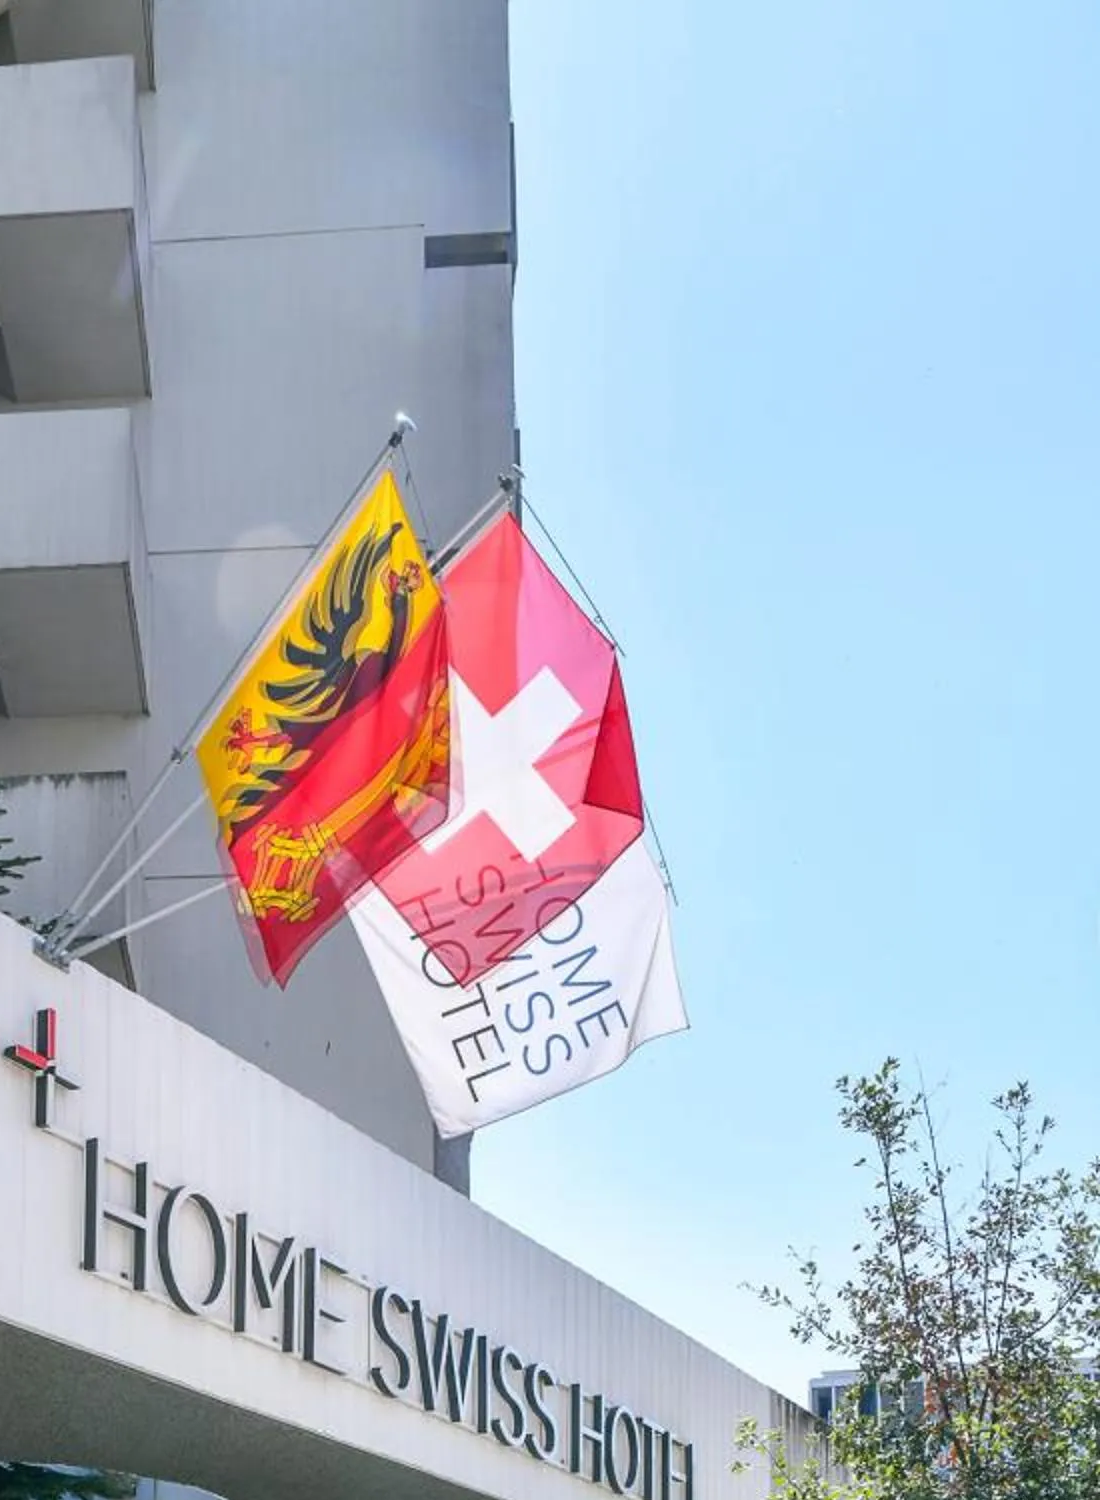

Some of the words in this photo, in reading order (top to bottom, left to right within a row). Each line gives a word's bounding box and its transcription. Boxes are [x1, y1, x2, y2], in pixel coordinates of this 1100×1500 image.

[399, 887, 511, 1103] HOTEL
[455, 864, 573, 1076] SWISS
[508, 845, 630, 1049] HOME
[79, 1137, 350, 1375] HOME
[370, 1285, 560, 1462] SWISS
